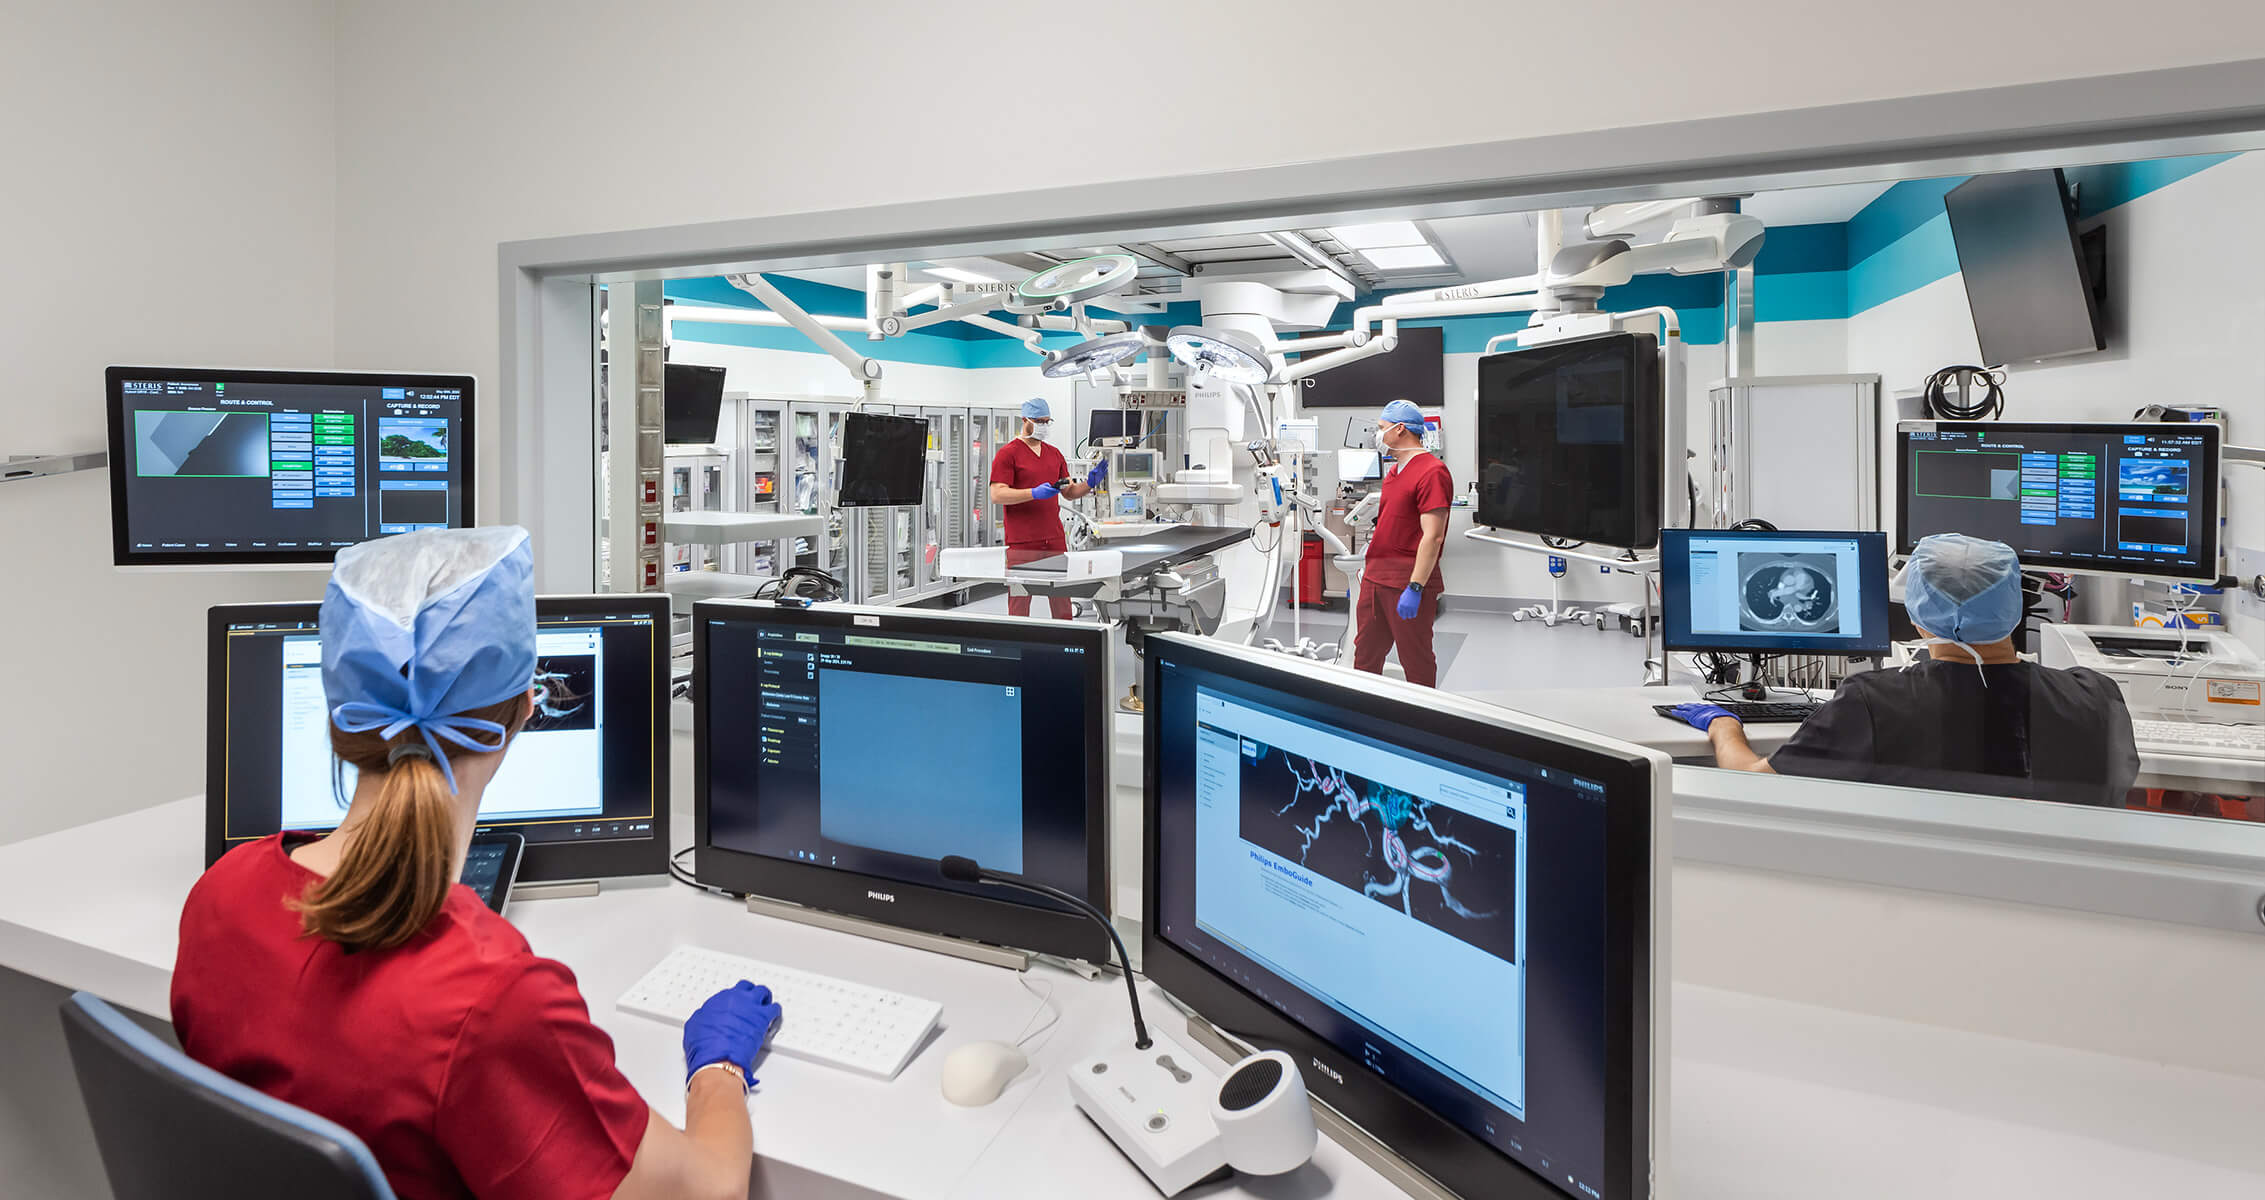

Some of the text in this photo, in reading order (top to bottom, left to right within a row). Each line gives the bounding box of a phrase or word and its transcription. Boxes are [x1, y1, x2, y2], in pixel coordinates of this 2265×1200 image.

[977, 282, 1016, 293] STERIS
[1444, 287, 1480, 299] STERIS
[1194, 391, 1221, 399] PHILIPS
[1573, 777, 1604, 793] PHILIPS
[1249, 849, 1313, 888] Philips EmboGuide
[867, 890, 895, 903] PHILIPS
[1312, 1056, 1344, 1085] PHILIPS
